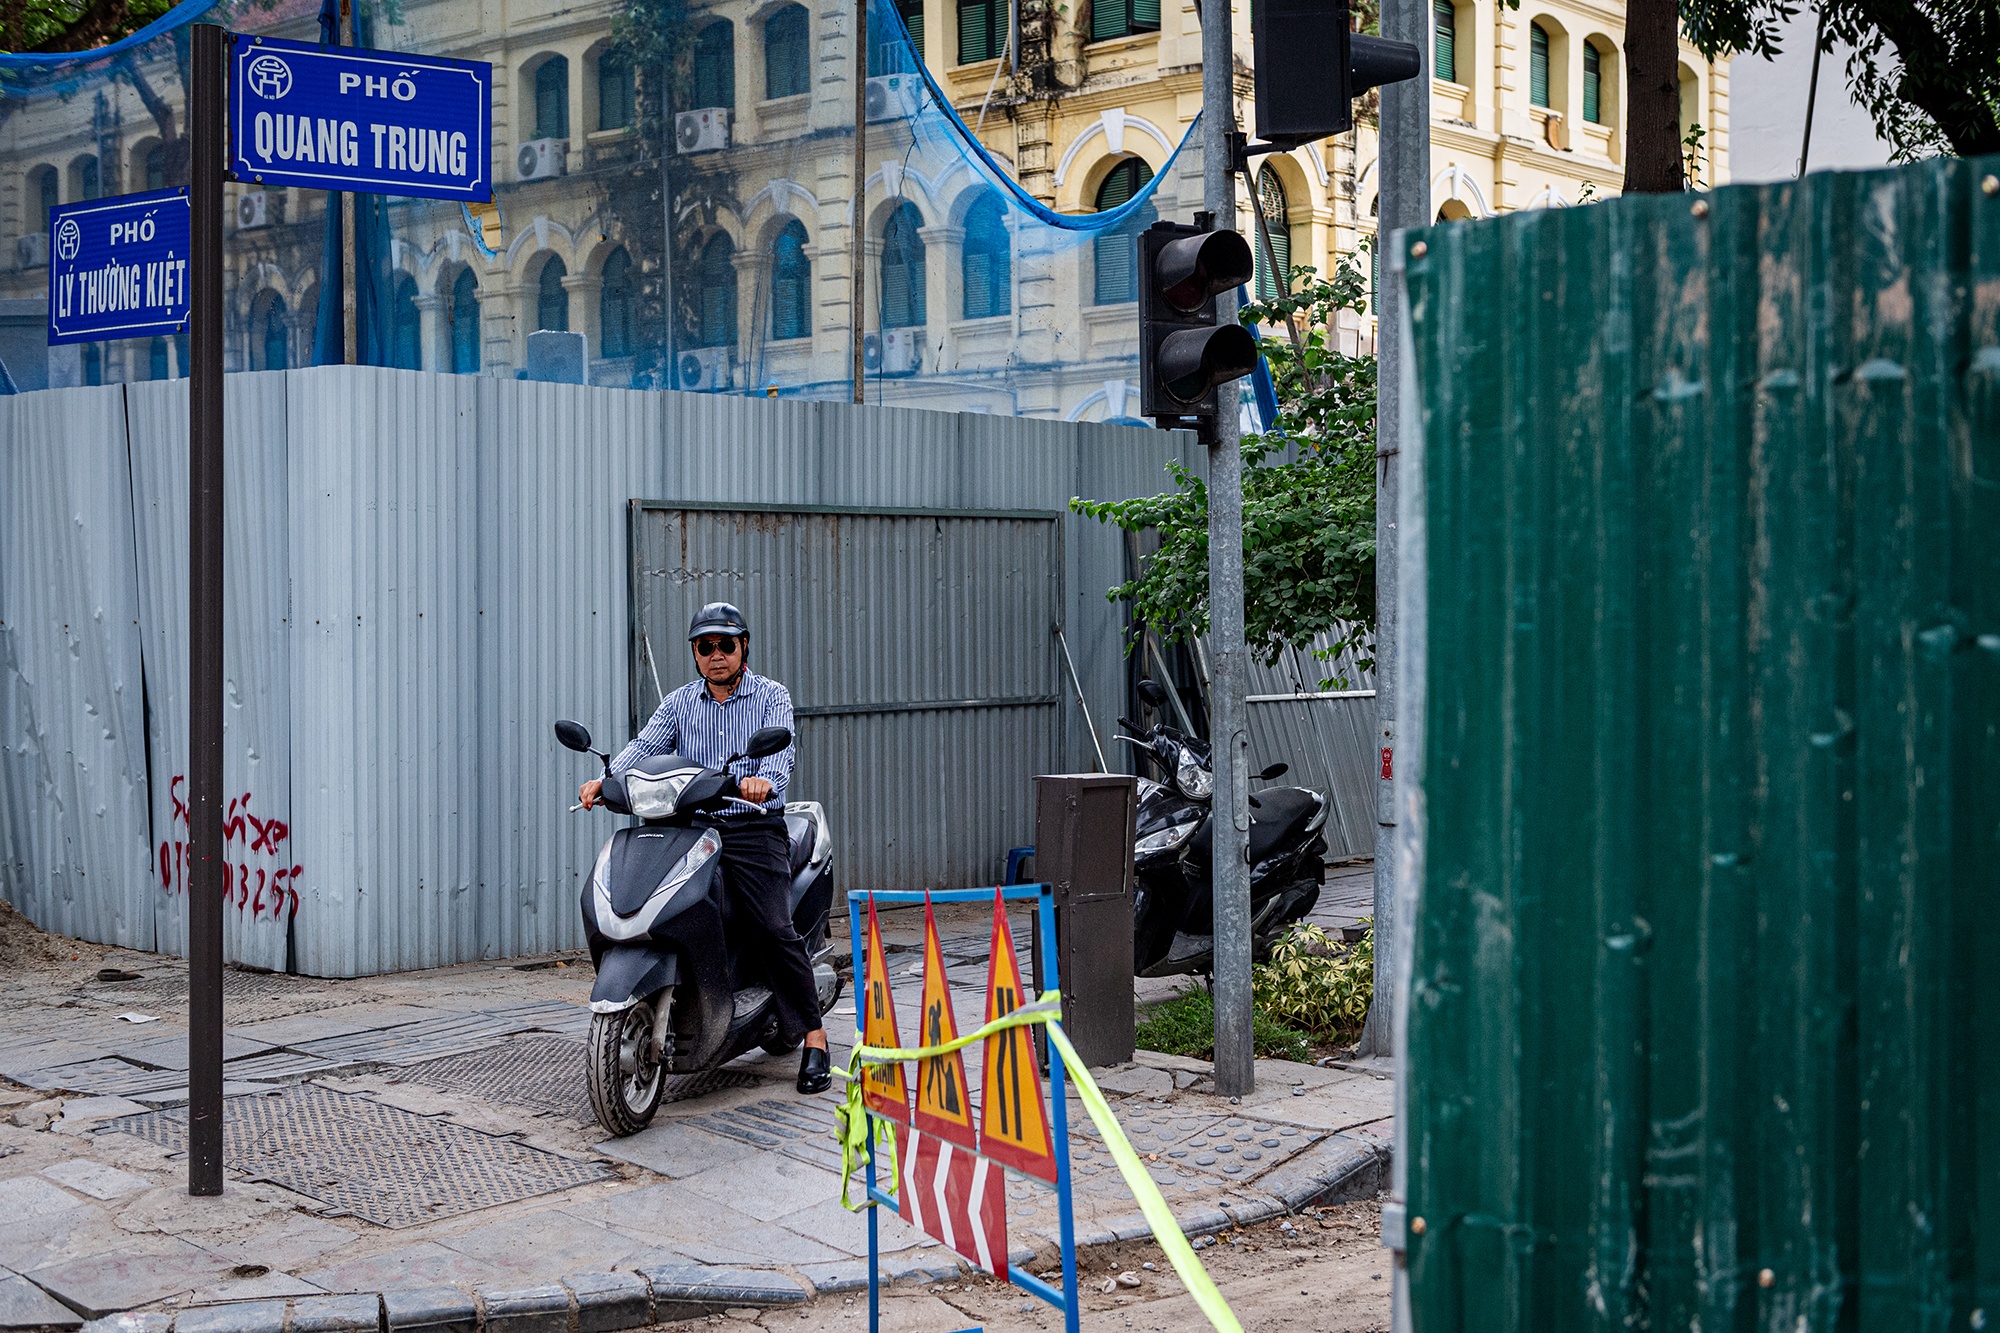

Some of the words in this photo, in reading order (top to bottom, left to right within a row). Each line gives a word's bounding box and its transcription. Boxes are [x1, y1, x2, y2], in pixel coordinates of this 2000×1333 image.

[339, 70, 420, 101] PHỐ
[254, 111, 358, 167] QUANG
[370, 123, 467, 176] TRUNG
[110, 209, 158, 246] PHỐ
[59, 264, 75, 318] LÝ
[79, 257, 141, 316] THƯỜNG
[146, 250, 186, 315] KIỆT
